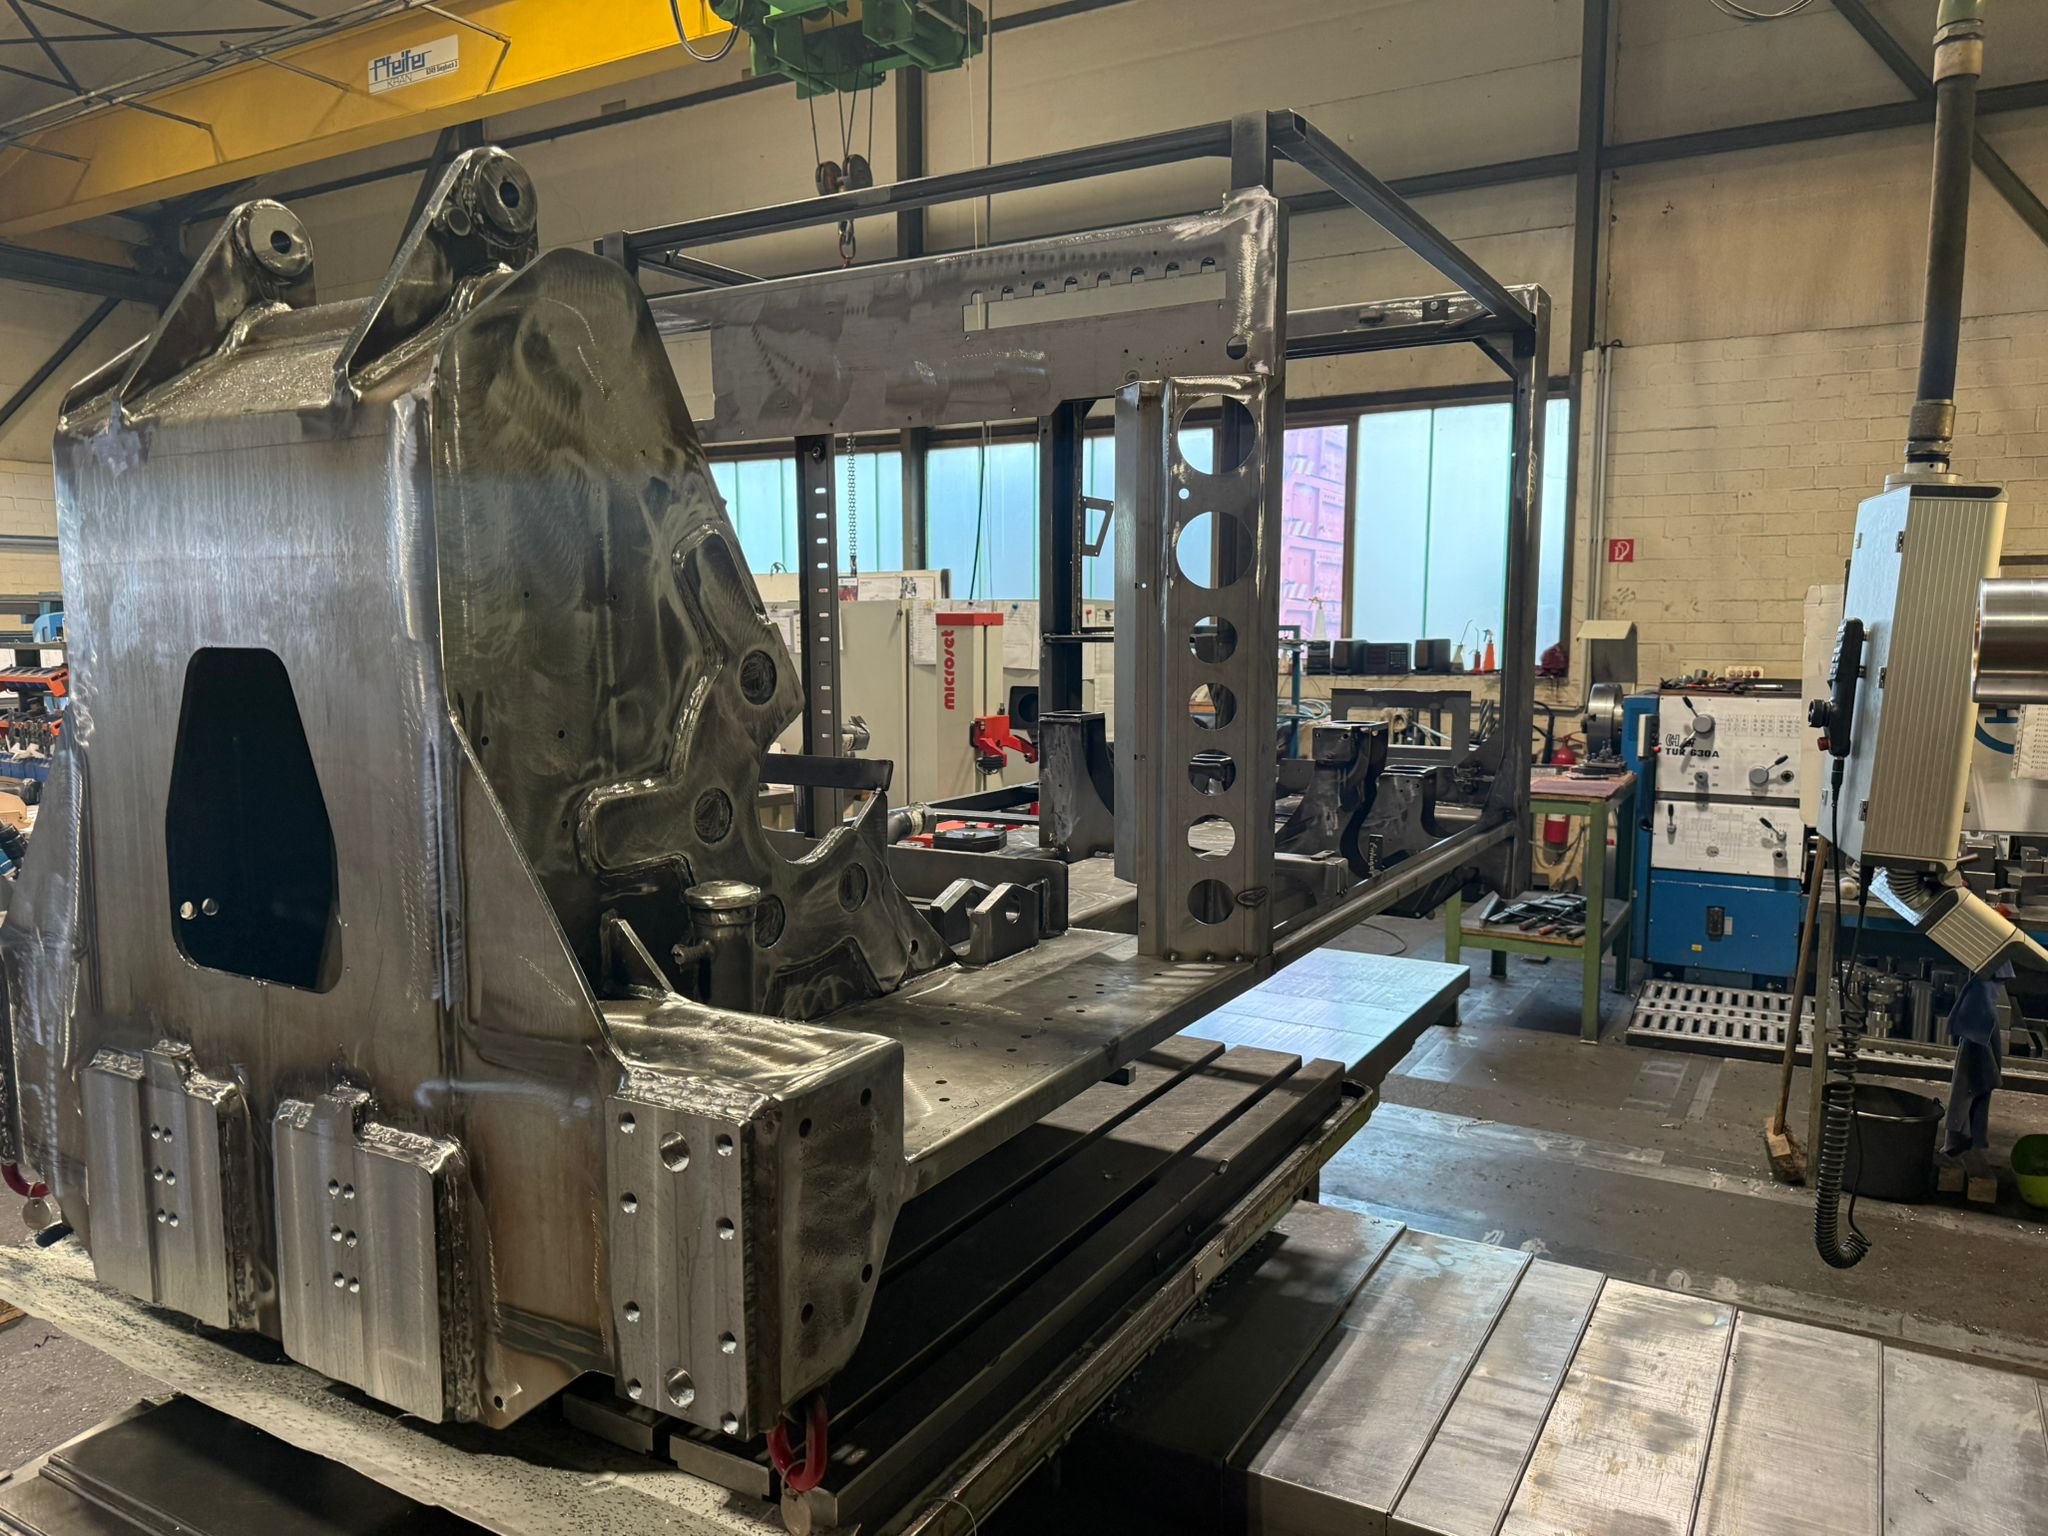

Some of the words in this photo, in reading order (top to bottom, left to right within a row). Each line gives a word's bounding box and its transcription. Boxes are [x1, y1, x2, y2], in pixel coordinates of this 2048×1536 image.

[369, 50, 432, 81] Pfeifer
[941, 629, 955, 710] microset
[1665, 747, 1685, 756] TUR
[1690, 748, 1719, 758] 630A
